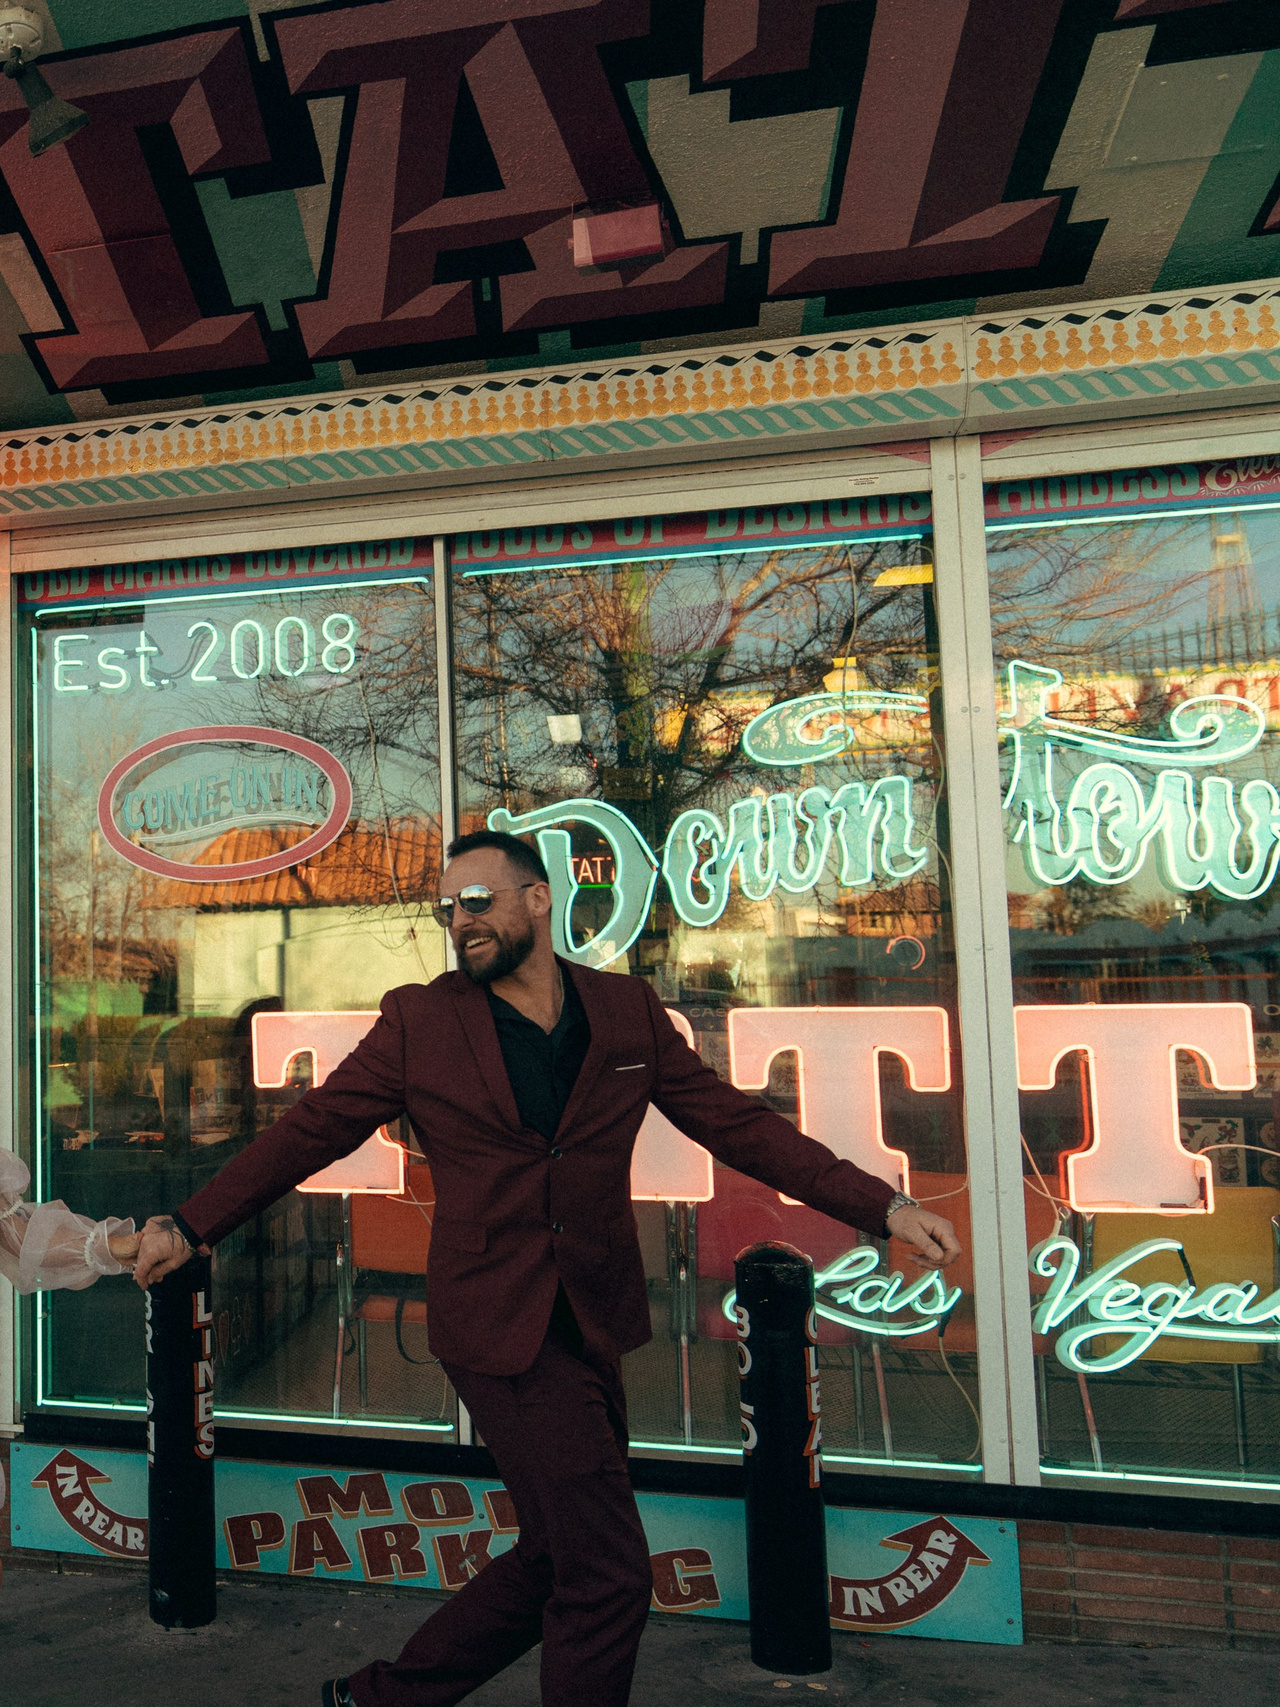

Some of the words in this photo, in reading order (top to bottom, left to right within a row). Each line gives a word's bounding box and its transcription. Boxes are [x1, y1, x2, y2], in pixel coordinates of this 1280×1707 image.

[53, 630, 170, 692] Est.
[187, 612, 356, 682] 2008
[122, 775, 220, 830] COME
[228, 766, 271, 809] ON
[282, 767, 321, 811] IN
[486, 775, 928, 970] Down
[1027, 1238, 1280, 1373] Vega
[56, 1463, 84, 1498] IN
[72, 1495, 146, 1552] REAR
[842, 1586, 886, 1617] IN
[883, 1528, 959, 1608] REAR
